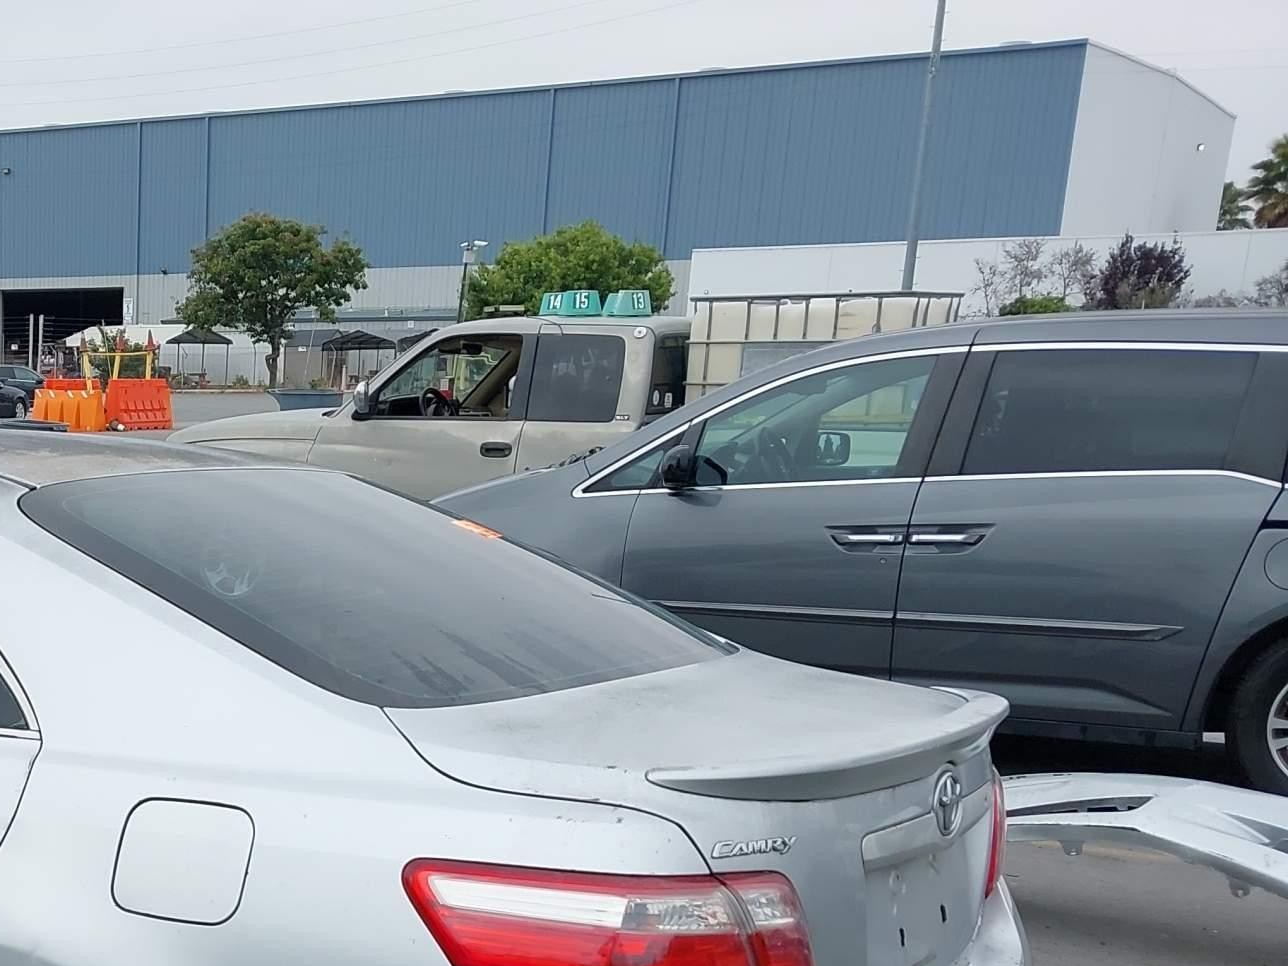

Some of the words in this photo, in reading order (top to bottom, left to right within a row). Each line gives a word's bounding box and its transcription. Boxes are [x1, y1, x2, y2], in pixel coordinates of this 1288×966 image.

[549, 294, 561, 309] 14
[575, 292, 589, 309] 15
[633, 292, 645, 309] 13
[711, 836, 797, 859] CAMRY
